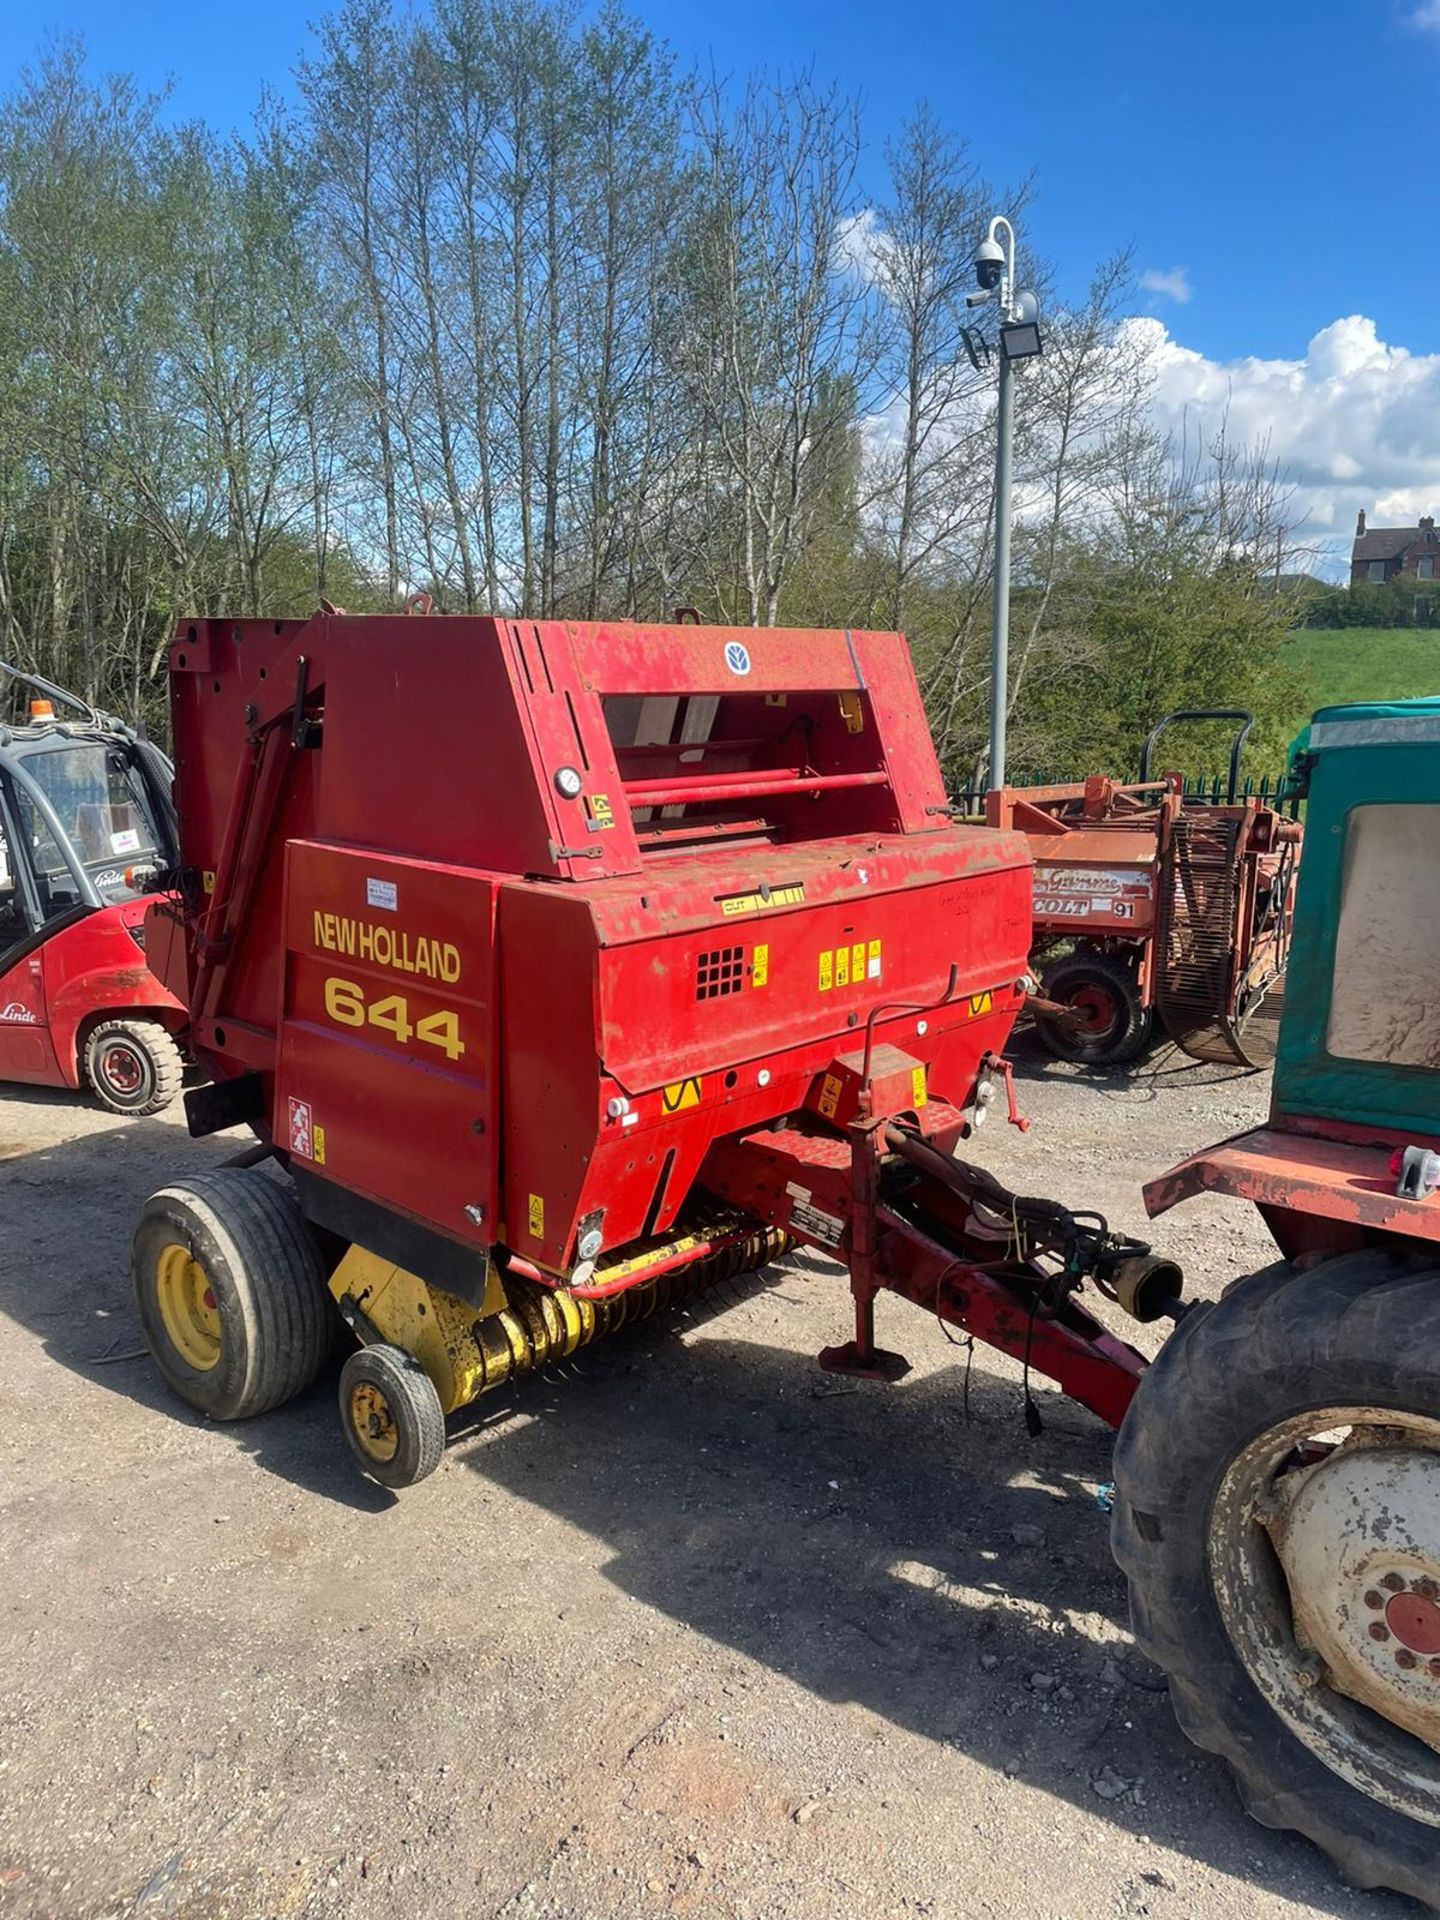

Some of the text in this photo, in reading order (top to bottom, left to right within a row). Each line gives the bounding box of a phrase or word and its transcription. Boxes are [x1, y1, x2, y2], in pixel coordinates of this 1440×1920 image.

[1033, 900, 1088, 915] COLT
[1115, 903, 1134, 917] 91
[314, 910, 461, 983] NEW HOLLAND
[0, 1002, 37, 1023] Linde
[324, 977, 466, 1060] 644
